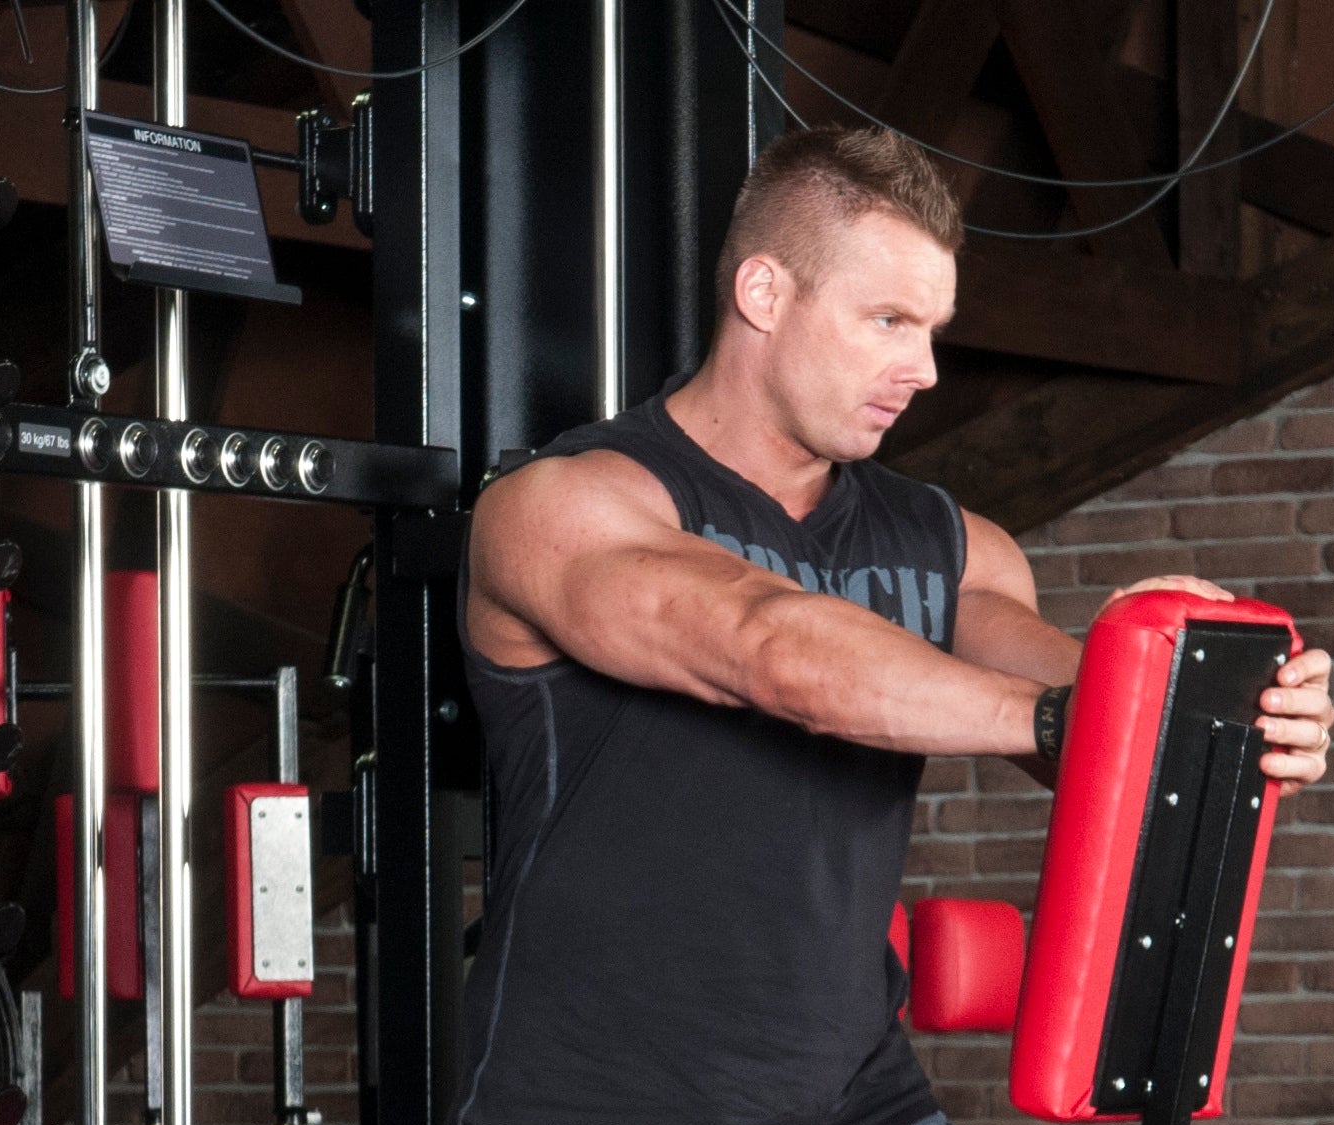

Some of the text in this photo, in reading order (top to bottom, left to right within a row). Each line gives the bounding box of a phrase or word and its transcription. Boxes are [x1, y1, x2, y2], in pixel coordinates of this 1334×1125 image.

[133, 128, 202, 153] INFORMATION
[20, 431, 32, 445] 30
[57, 435, 70, 449] lbs
